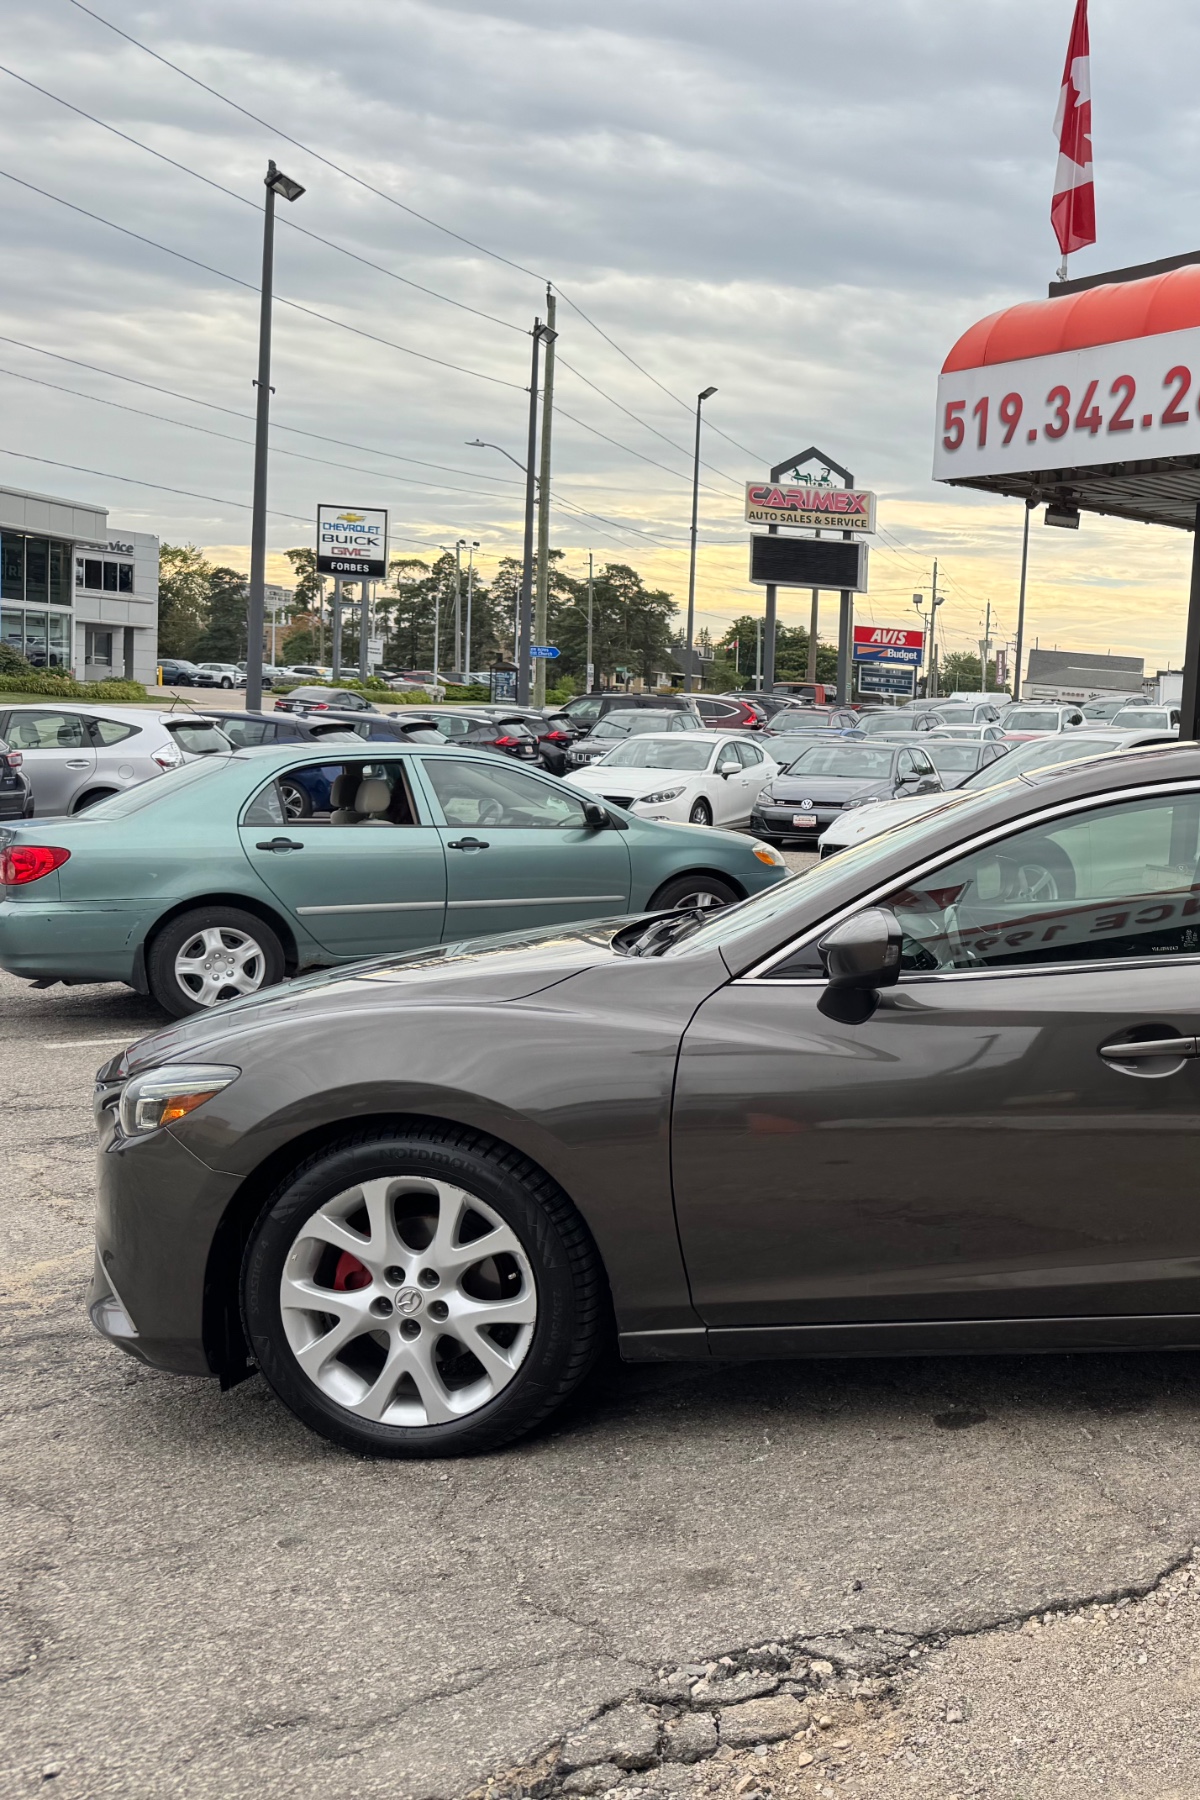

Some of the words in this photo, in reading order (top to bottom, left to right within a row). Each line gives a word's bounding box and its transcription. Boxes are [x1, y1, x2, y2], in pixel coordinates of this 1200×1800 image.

[748, 487, 867, 513] CARIMEX
[749, 511, 777, 520] AUTO
[780, 513, 812, 524] SALES
[814, 516, 822, 525] &
[825, 516, 867, 528] SERVICE
[323, 522, 380, 535] CHEVROLET
[322, 534, 380, 547] BUICK
[331, 547, 371, 557] GMC
[330, 562, 369, 572] FORBES
[870, 629, 907, 645] AVIS
[887, 648, 918, 661] Budget
